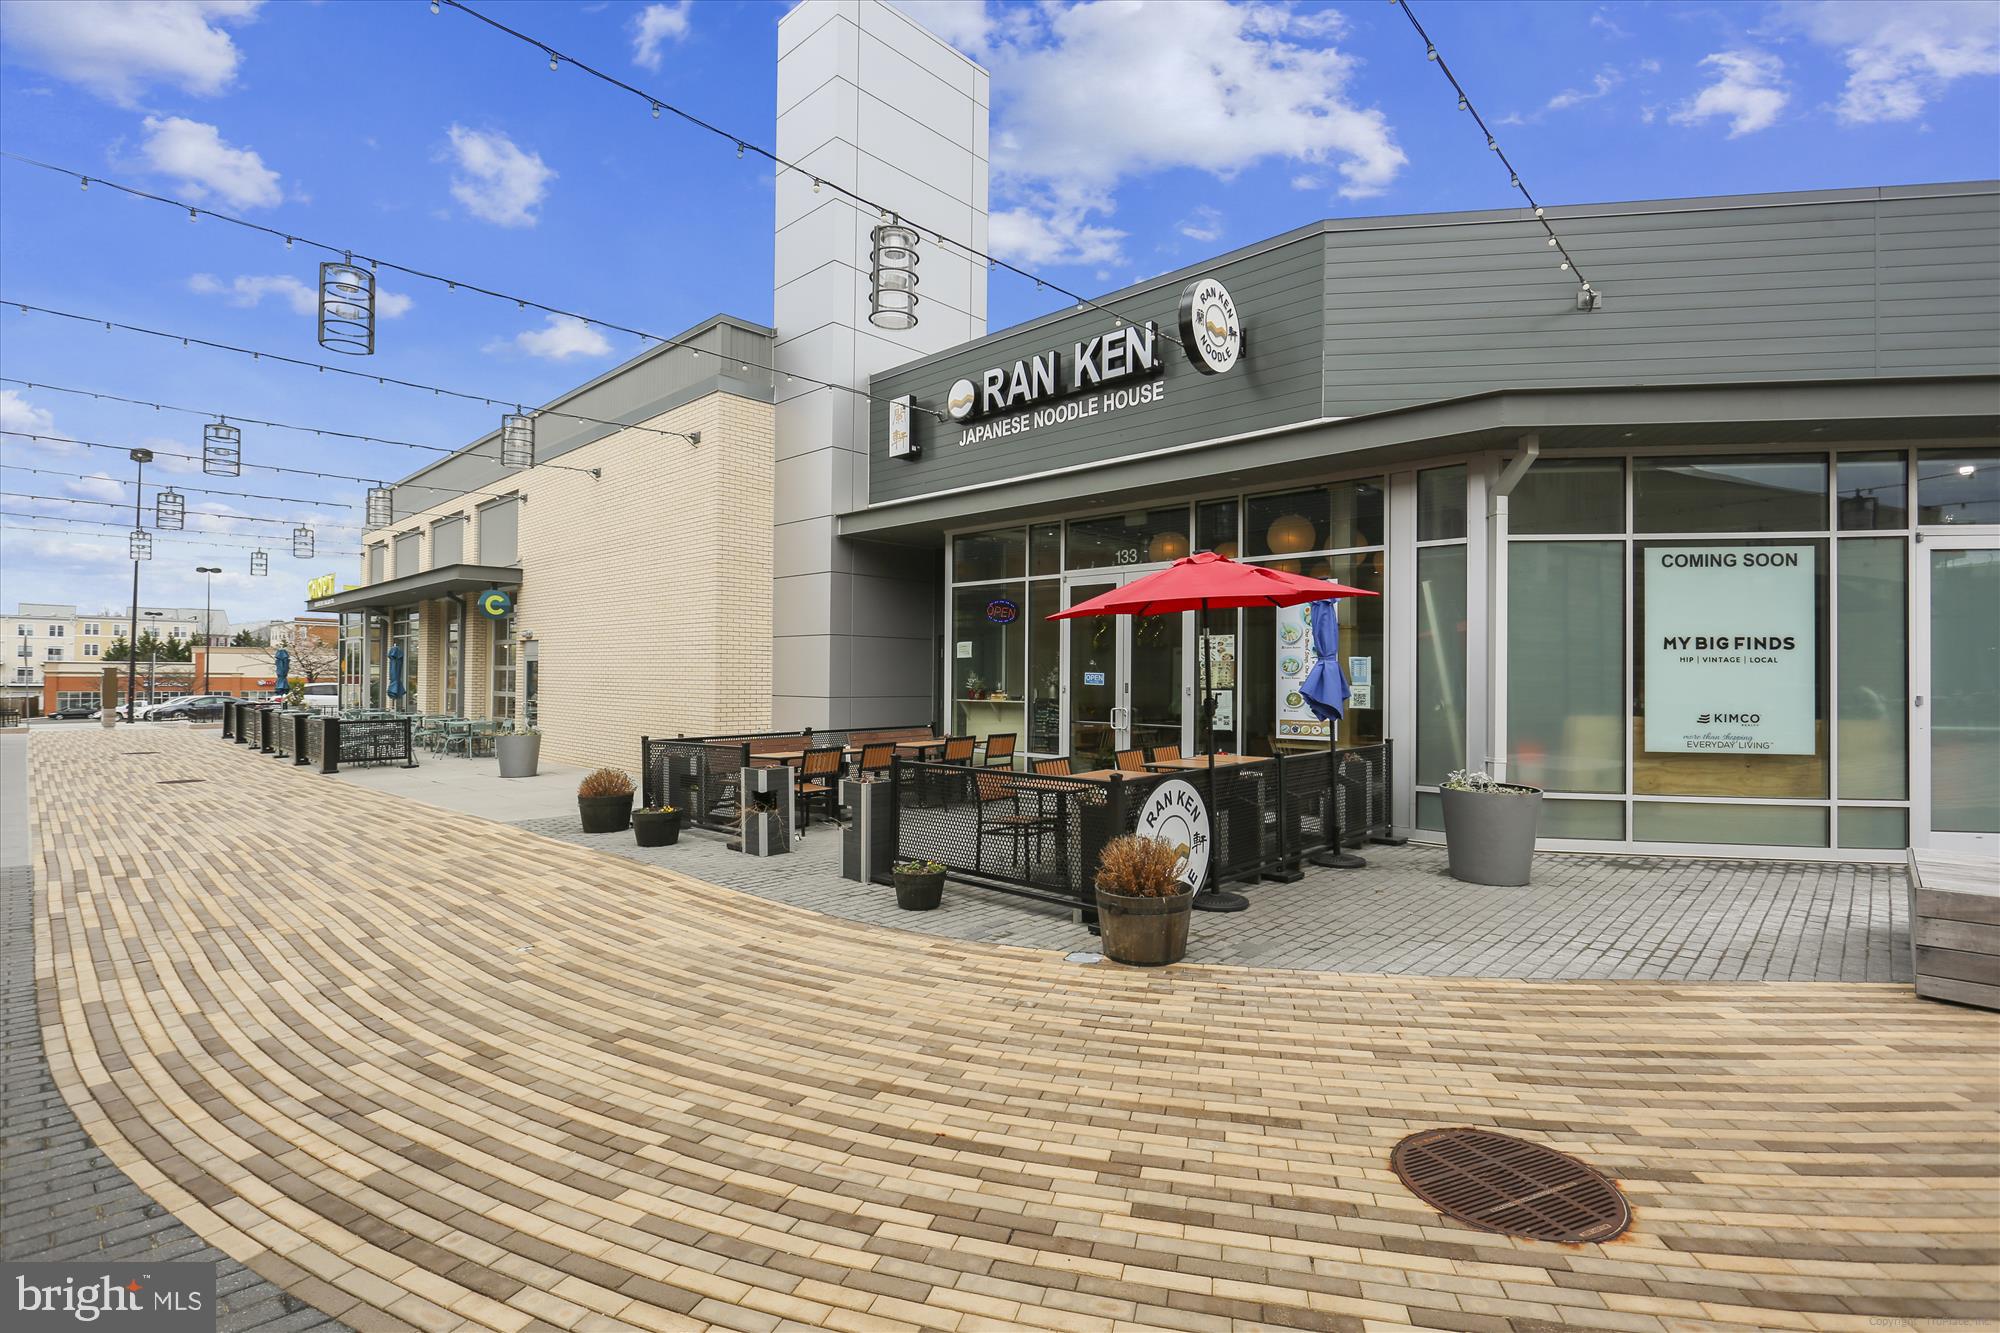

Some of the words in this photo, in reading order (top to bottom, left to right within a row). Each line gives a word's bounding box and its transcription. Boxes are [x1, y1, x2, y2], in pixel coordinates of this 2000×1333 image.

[1200, 287, 1216, 304] RAN
[1218, 291, 1234, 319] KEN
[1200, 334, 1232, 362] NOODLE
[983, 350, 1055, 412] RAN
[1074, 321, 1153, 388] KEN
[959, 414, 1030, 447] JAPANESE
[1034, 397, 1099, 428] NOODLE
[1103, 381, 1164, 413] HOUSE
[1115, 548, 1138, 564] 133
[1661, 553, 1737, 568] COMING
[1743, 553, 1798, 567] SOON
[484, 594, 505, 616] C
[986, 604, 1017, 619] OPEN
[1663, 637, 1692, 650] MY
[1695, 637, 1729, 650] BIG
[1734, 637, 1795, 650] FINDS
[1714, 713, 1760, 723] KIMCO
[1686, 741, 1736, 749] EVERYDAY
[1738, 741, 1770, 749] LIVING
[1146, 790, 1172, 828] RAN
[1176, 790, 1201, 823] KEN
